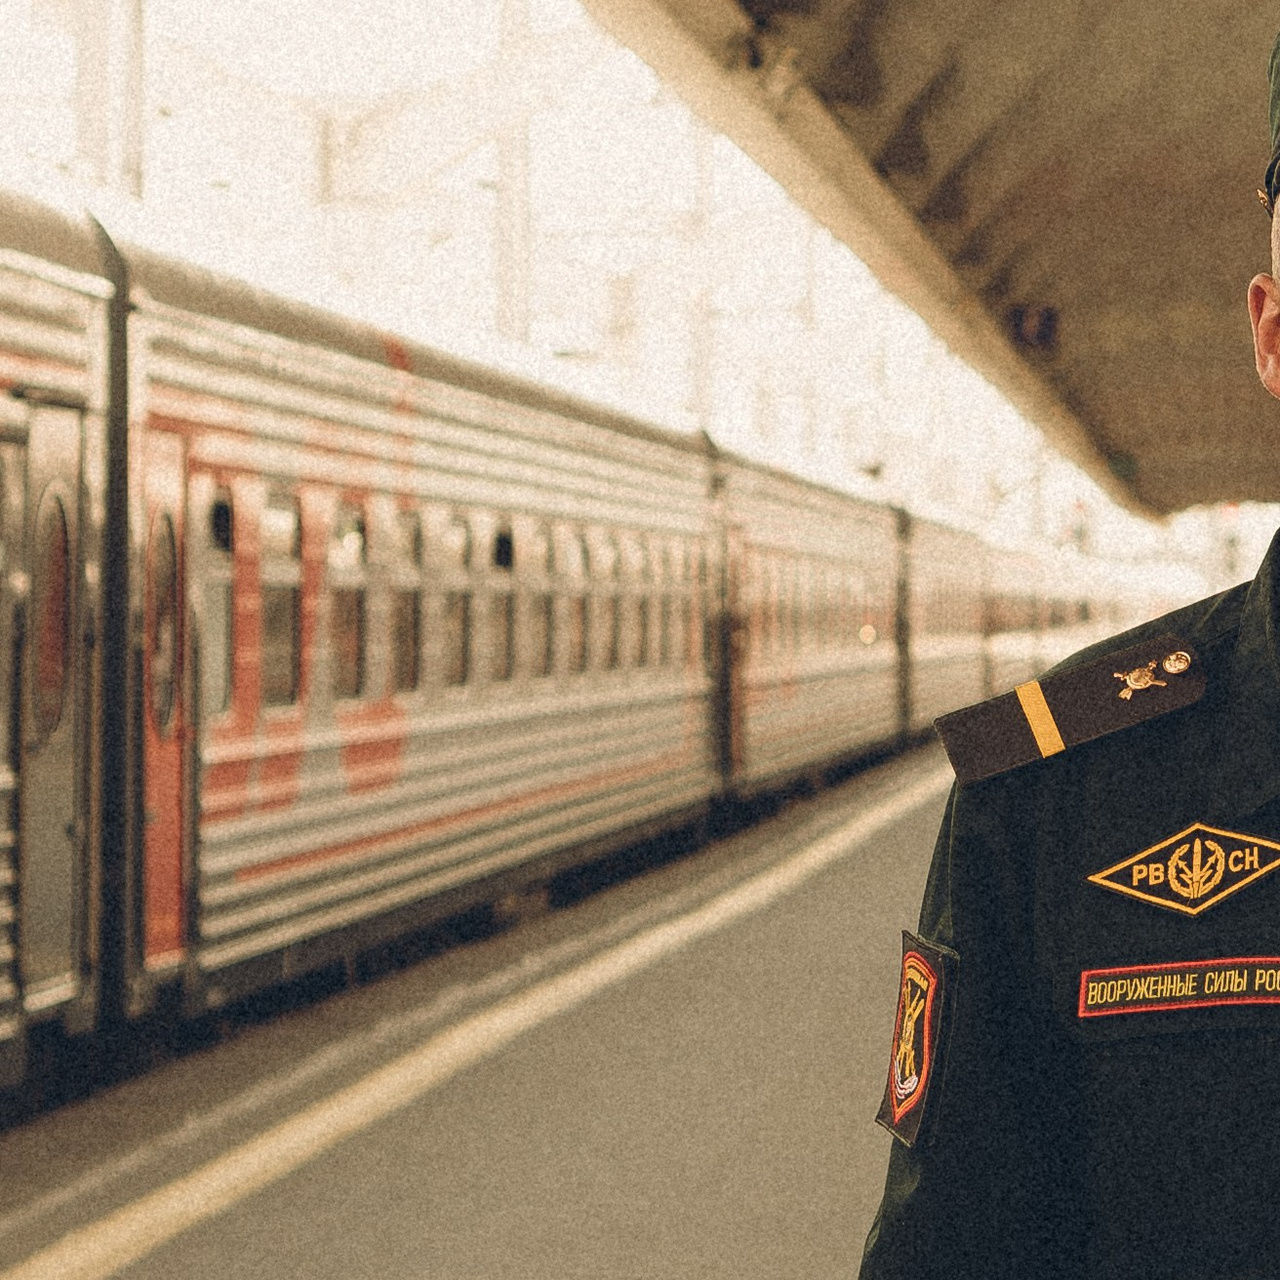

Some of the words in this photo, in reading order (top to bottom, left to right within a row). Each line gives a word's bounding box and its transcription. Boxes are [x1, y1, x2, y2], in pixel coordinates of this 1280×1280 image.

[1132, 864, 1165, 886] РВ
[1228, 847, 1260, 872] СН
[1088, 974, 1198, 1005] ВООРУЖЕННЫЕ
[1203, 969, 1247, 994] СИЛЫ
